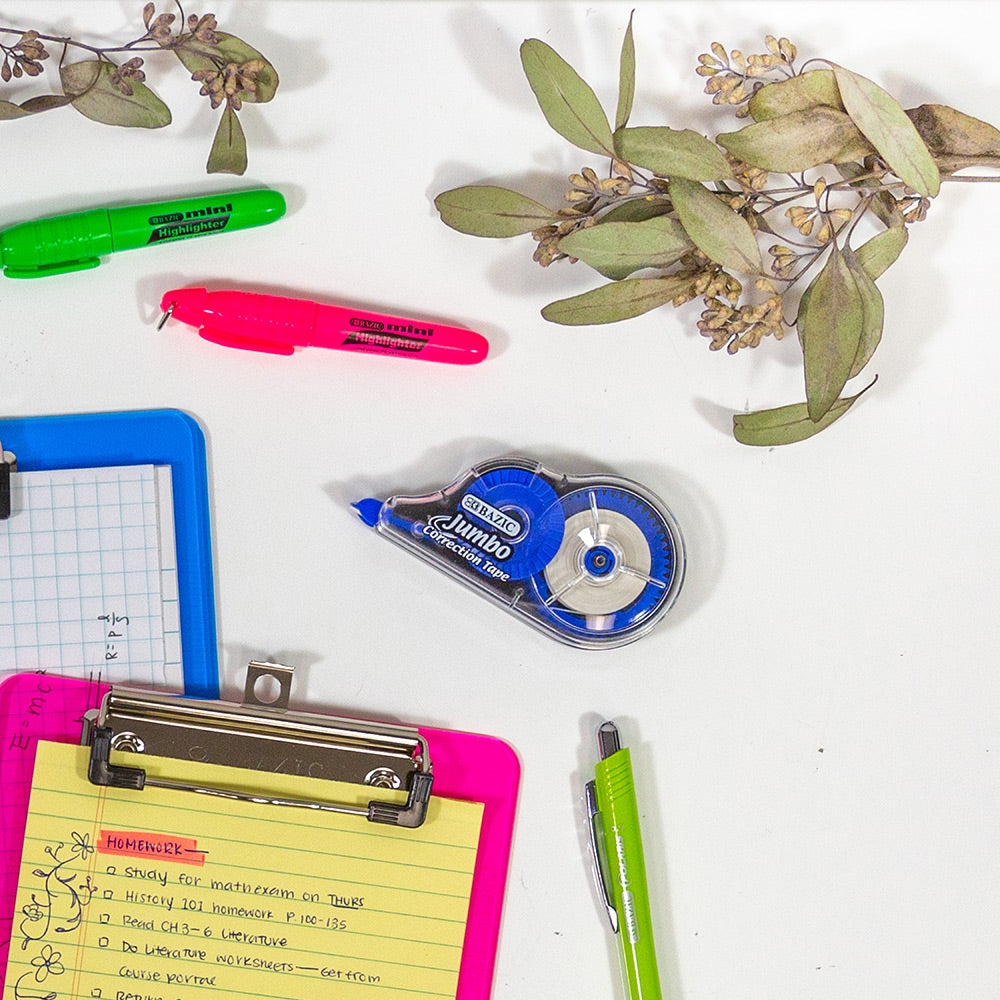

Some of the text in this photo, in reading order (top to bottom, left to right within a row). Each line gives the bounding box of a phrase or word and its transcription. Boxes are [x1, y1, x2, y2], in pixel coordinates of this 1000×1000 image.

[186, 203, 233, 218] mini
[158, 219, 226, 238] Highlighter
[387, 324, 434, 336] mini
[355, 332, 423, 350] Highlighter
[479, 504, 517, 533] BAZIC
[441, 513, 512, 560] Jumbo
[422, 524, 511, 582] Correction Tape
[107, 835, 183, 855] HOMEWORK
[124, 866, 168, 886] Study
[178, 873, 202, 886] for
[254, 884, 295, 900] exam
[302, 891, 320, 902] on
[328, 893, 366, 908] THURS
[125, 890, 174, 911] History
[182, 898, 204, 912] 101
[211, 902, 275, 920] homework
[300, 915, 348, 930] 100-135
[122, 914, 155, 931] Read
[122, 940, 139, 954] Do
